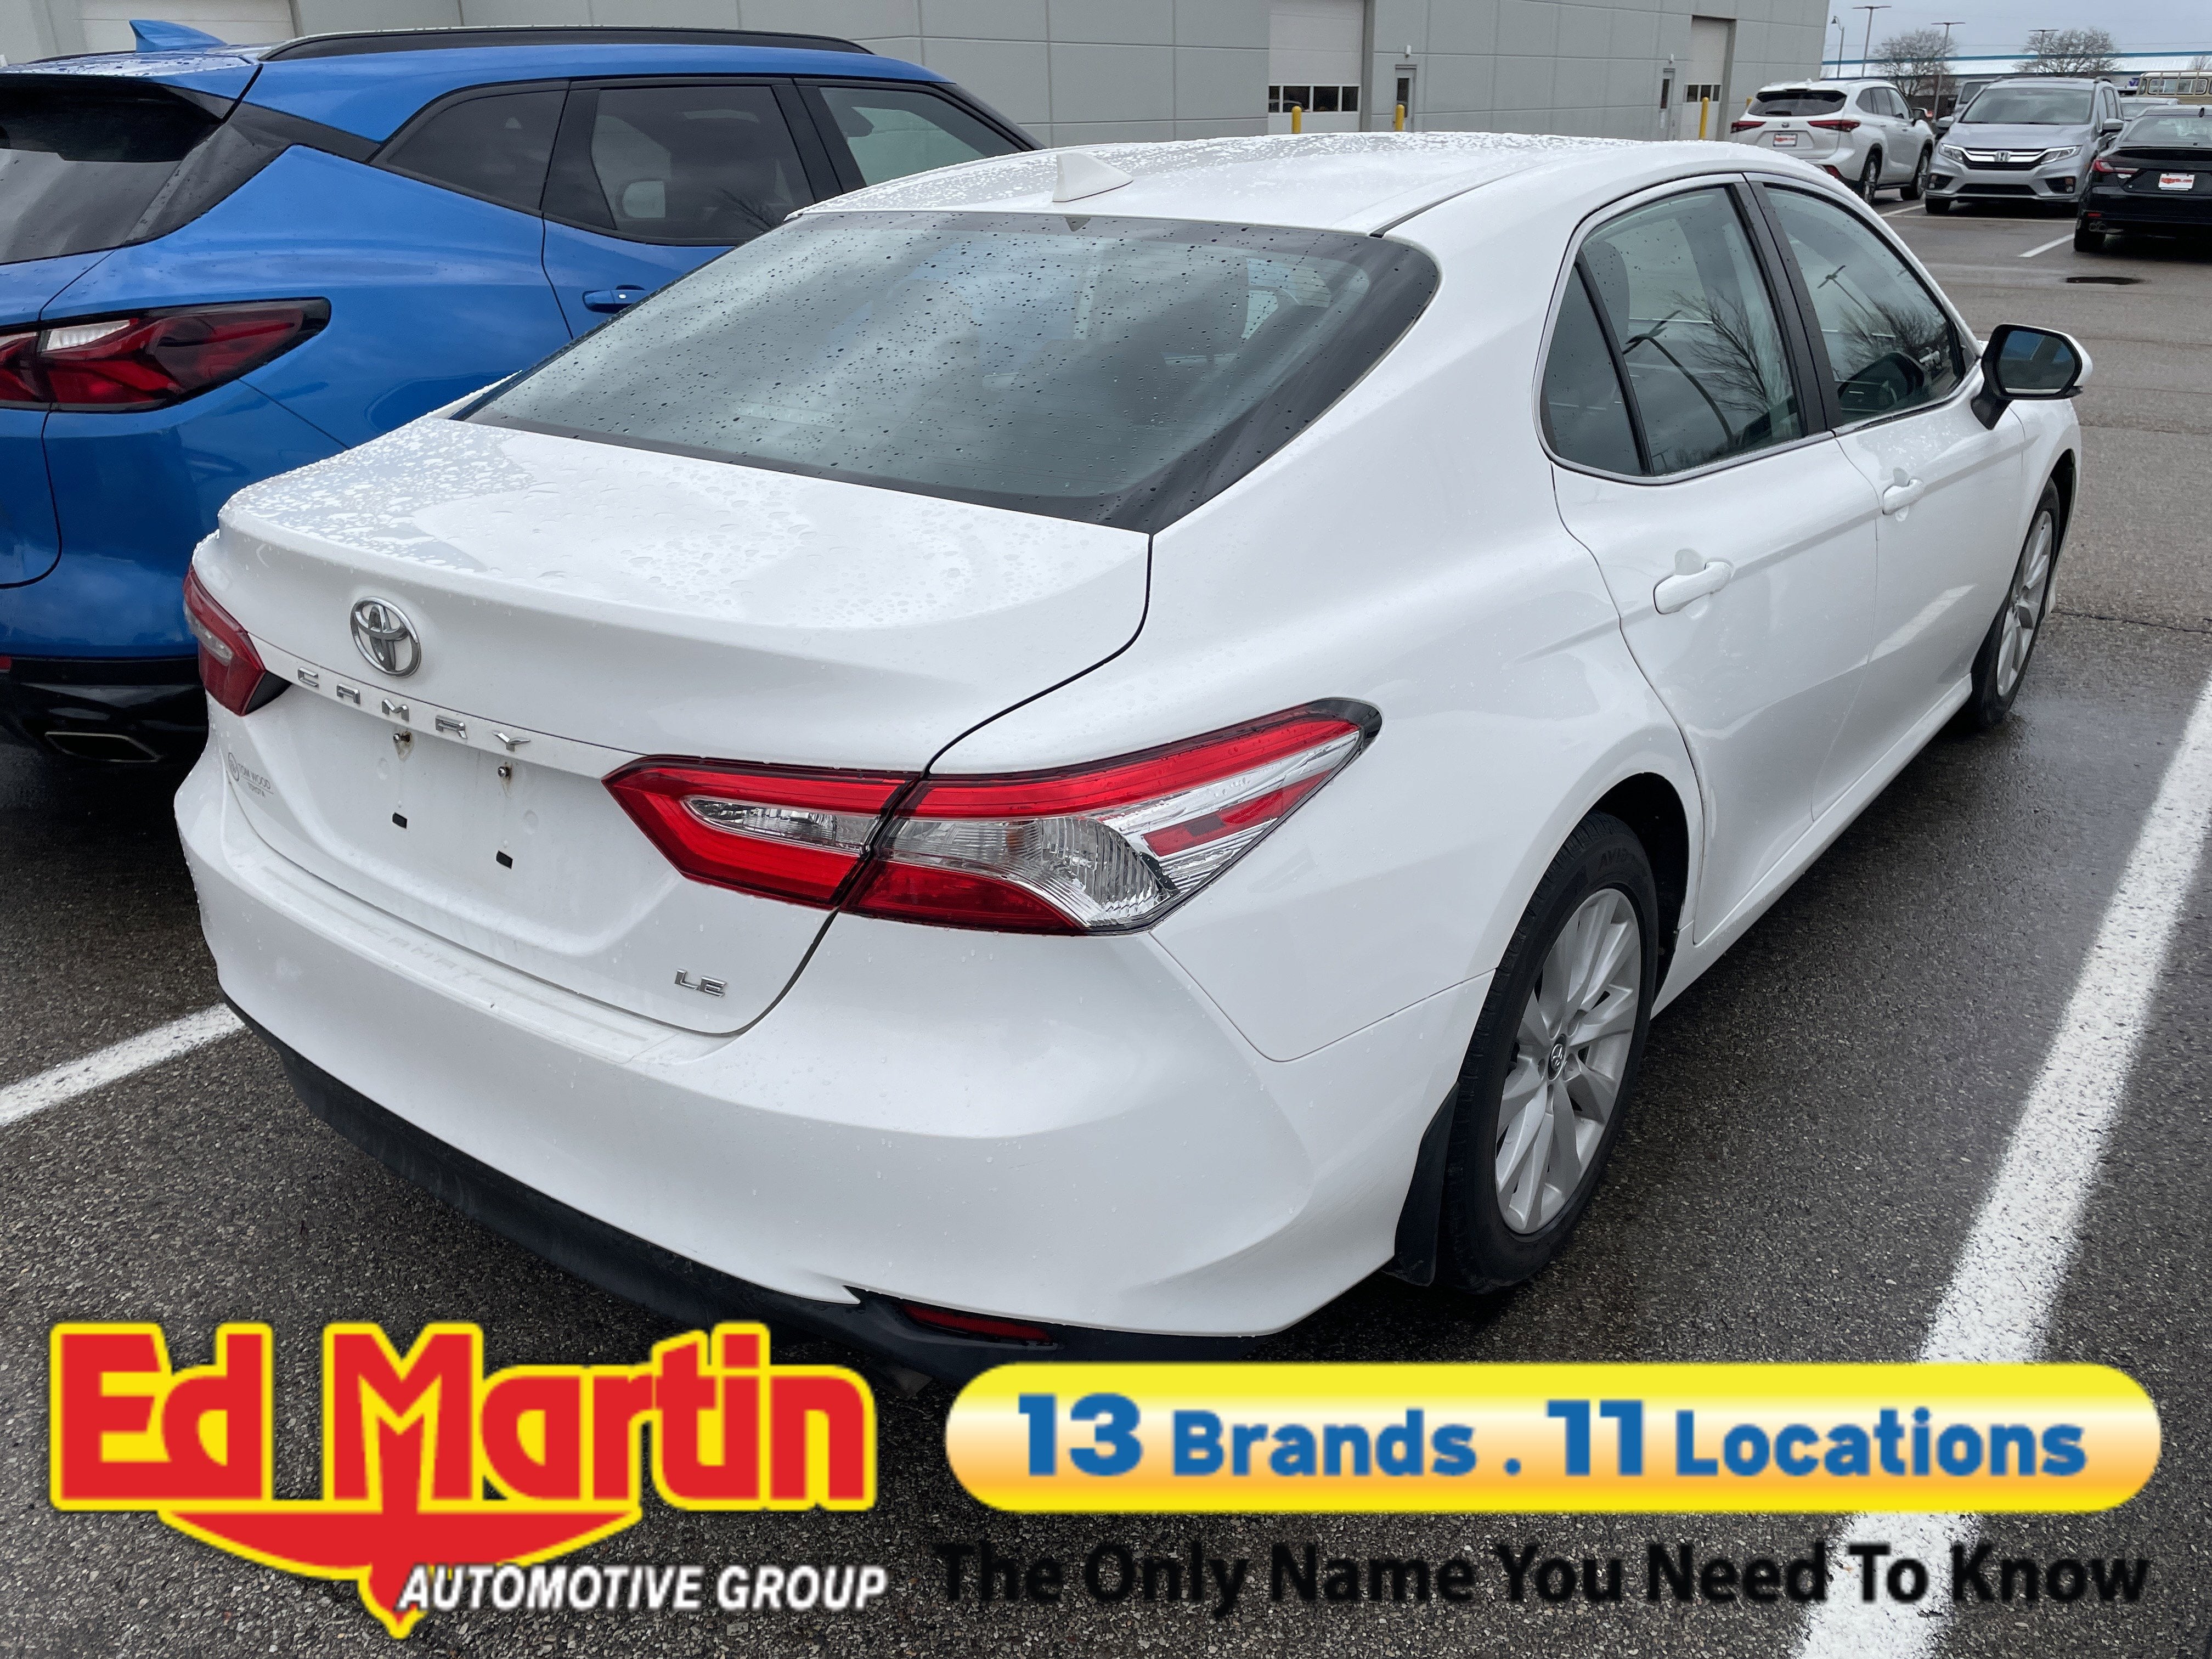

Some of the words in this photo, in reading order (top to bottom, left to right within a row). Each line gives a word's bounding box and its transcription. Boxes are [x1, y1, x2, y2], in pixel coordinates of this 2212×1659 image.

[298, 667, 531, 752] CAMRY
[251, 772, 271, 789] WOOD
[674, 968, 728, 997] LE
